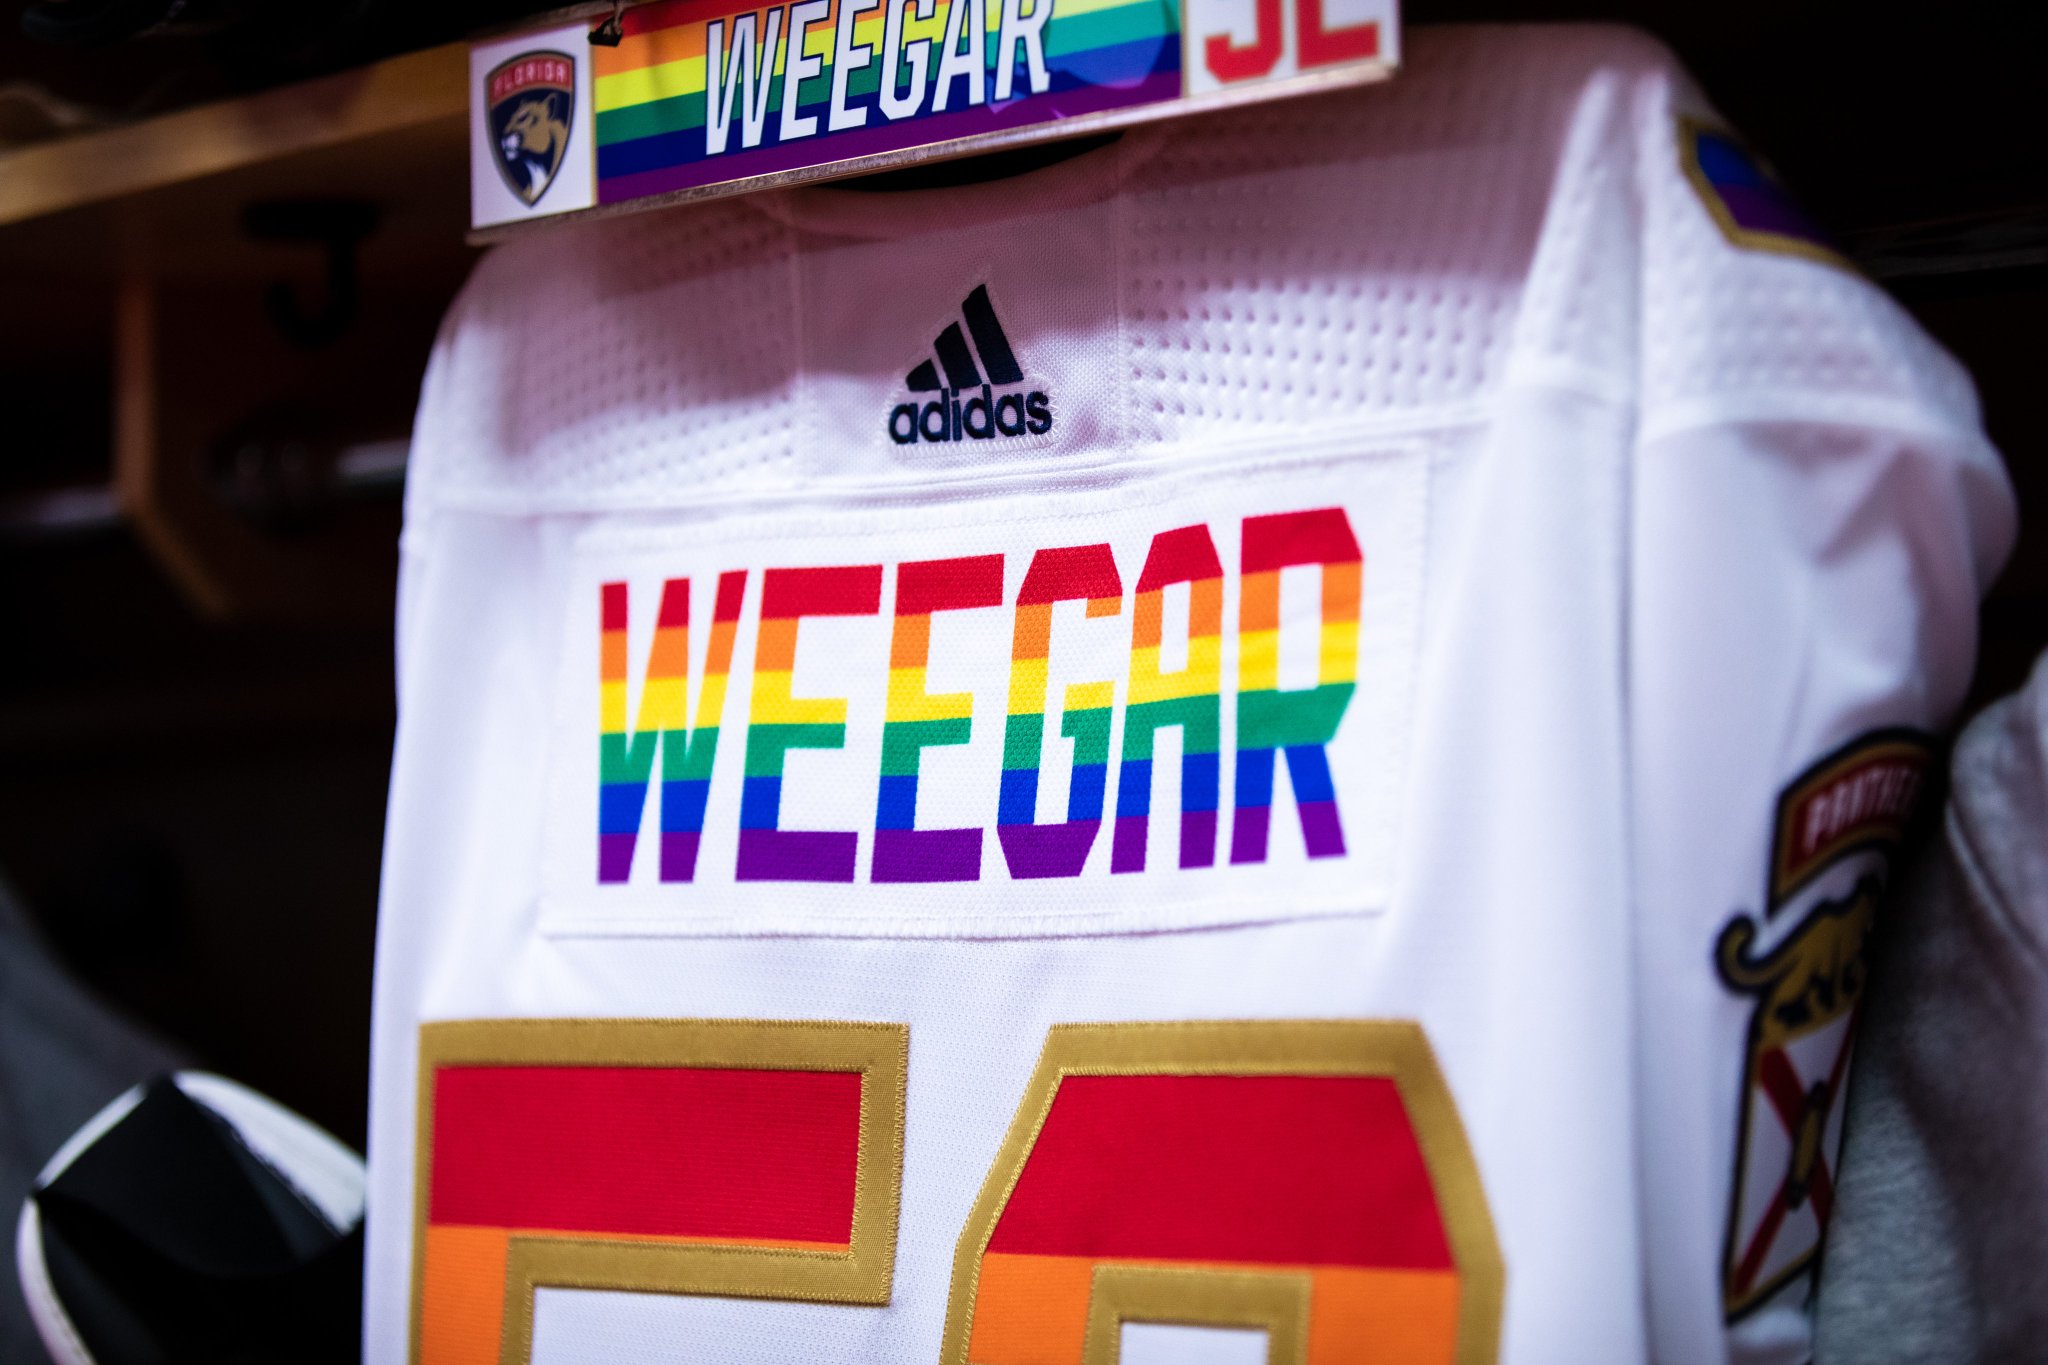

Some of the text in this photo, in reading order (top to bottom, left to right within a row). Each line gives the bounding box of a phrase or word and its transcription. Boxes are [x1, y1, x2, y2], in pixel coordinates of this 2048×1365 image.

[494, 61, 566, 97] FLORIDA
[705, 0, 1052, 156] WEEGAR
[888, 383, 1053, 445] adidas
[597, 506, 1364, 884] WEEGAR
